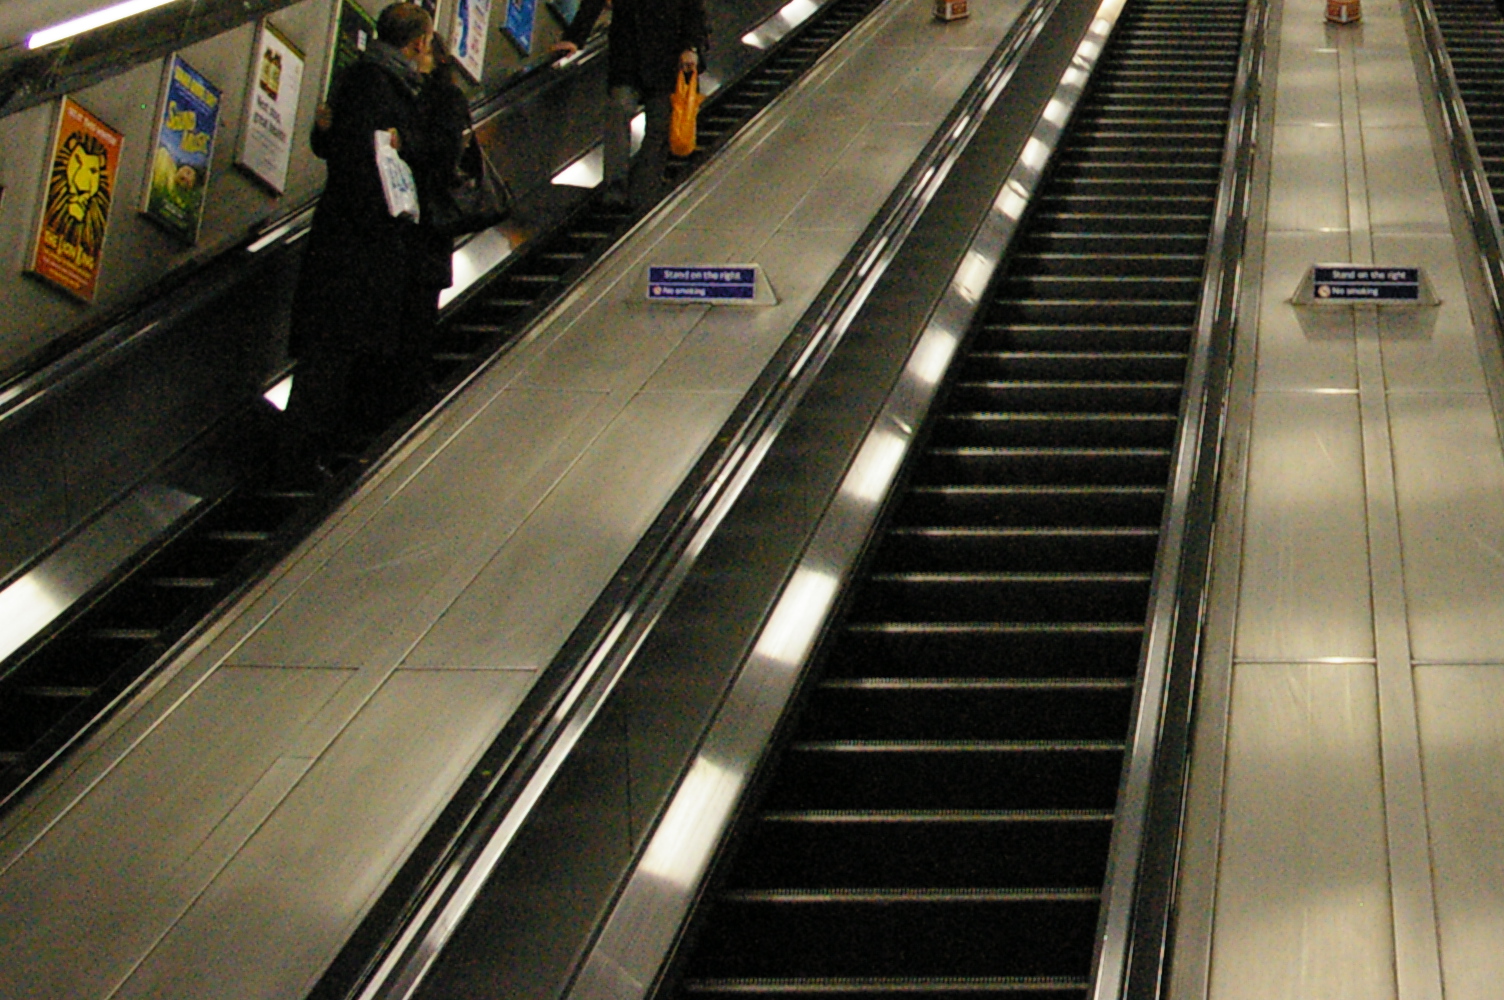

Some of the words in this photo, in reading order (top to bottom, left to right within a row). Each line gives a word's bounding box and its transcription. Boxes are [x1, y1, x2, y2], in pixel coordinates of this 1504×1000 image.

[664, 271, 689, 280] Stand
[703, 271, 719, 280] the
[719, 271, 741, 282] right
[1333, 271, 1356, 280] Stand
[1370, 271, 1386, 280] the
[1387, 271, 1406, 281] right
[675, 287, 706, 296] smoking
[1331, 286, 1345, 295] No
[1346, 287, 1379, 297] smoking
